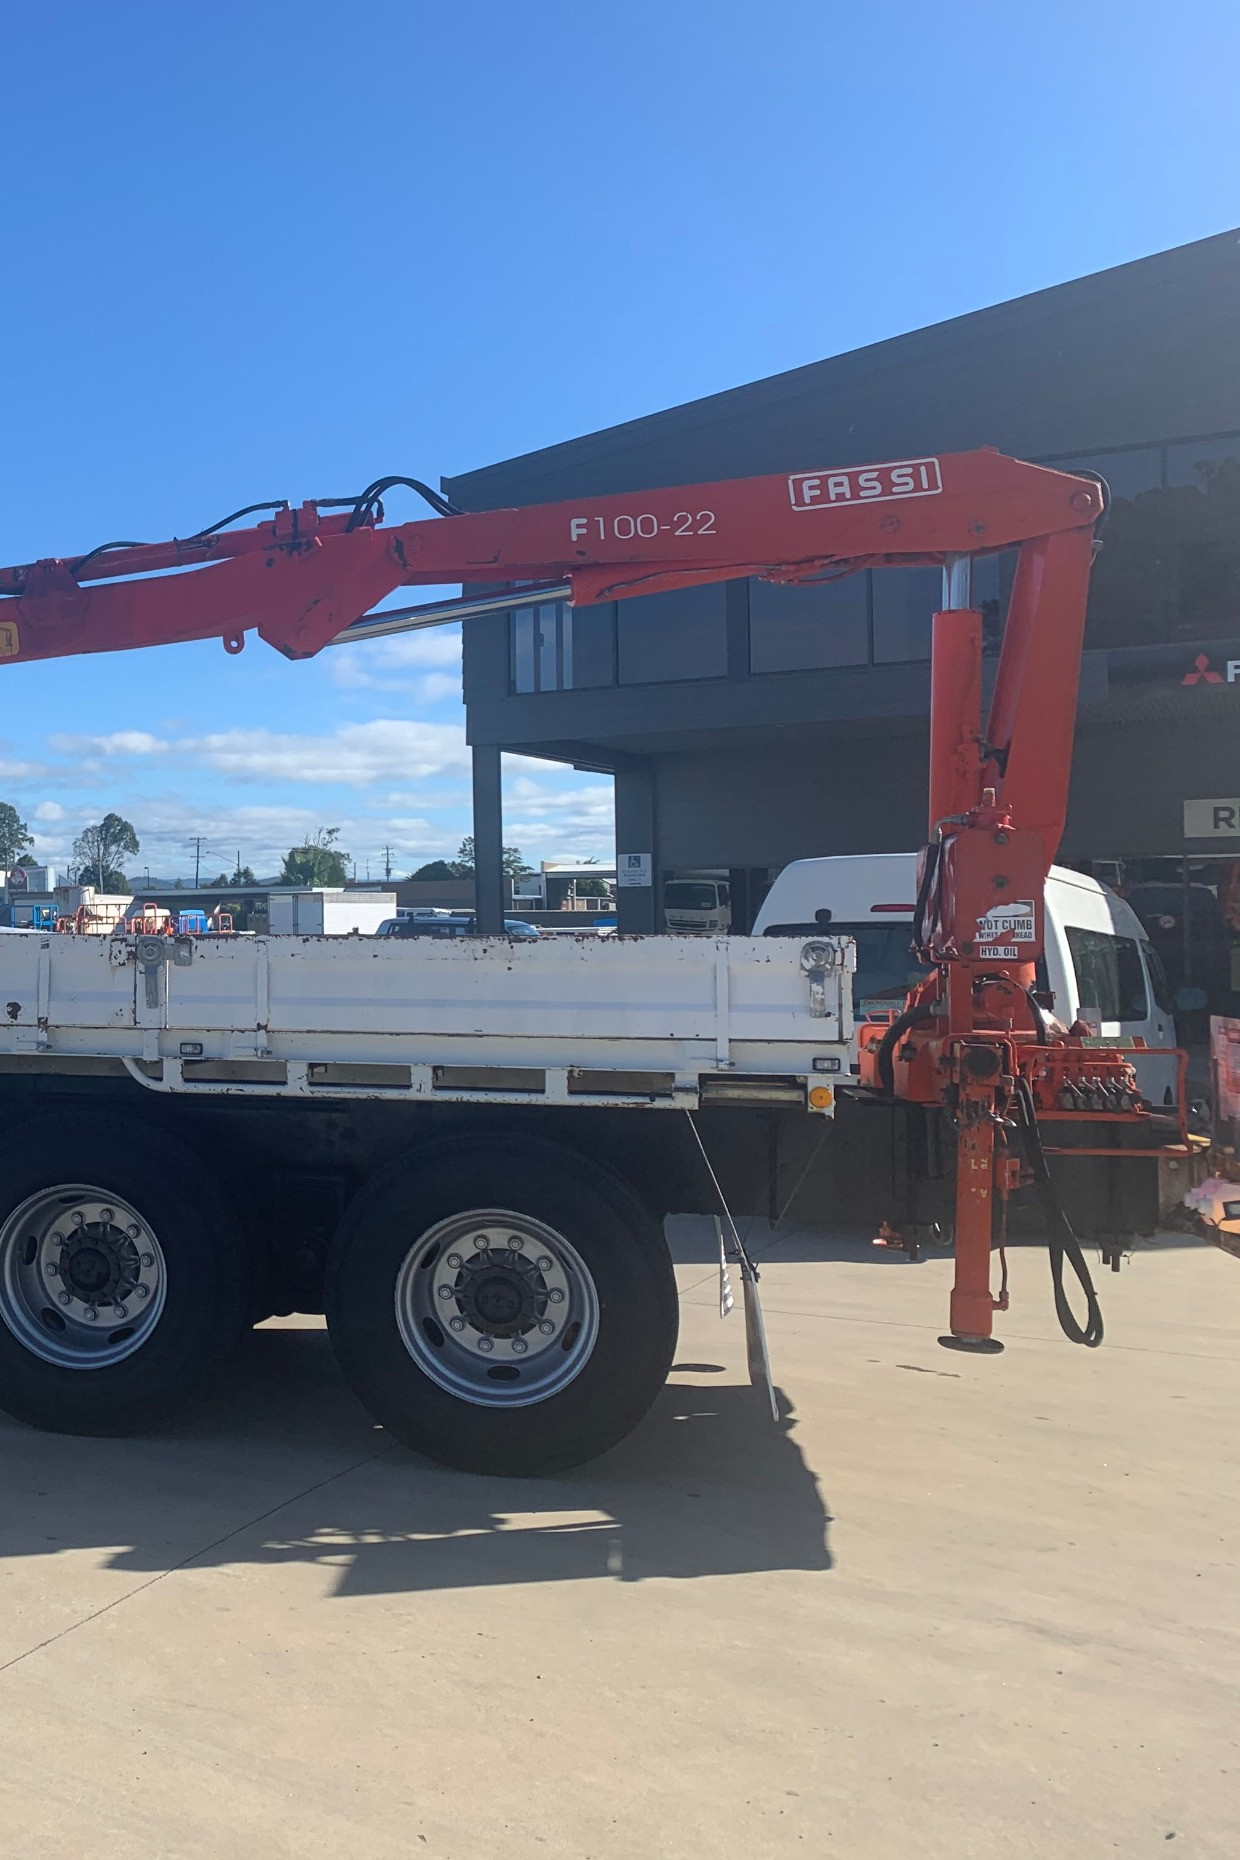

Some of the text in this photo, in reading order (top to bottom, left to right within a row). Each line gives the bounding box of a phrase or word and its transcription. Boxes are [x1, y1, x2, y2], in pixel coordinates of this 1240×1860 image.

[802, 465, 931, 504] FASSI
[570, 511, 717, 541] F100-22
[981, 947, 1017, 957] HYD. OIL
